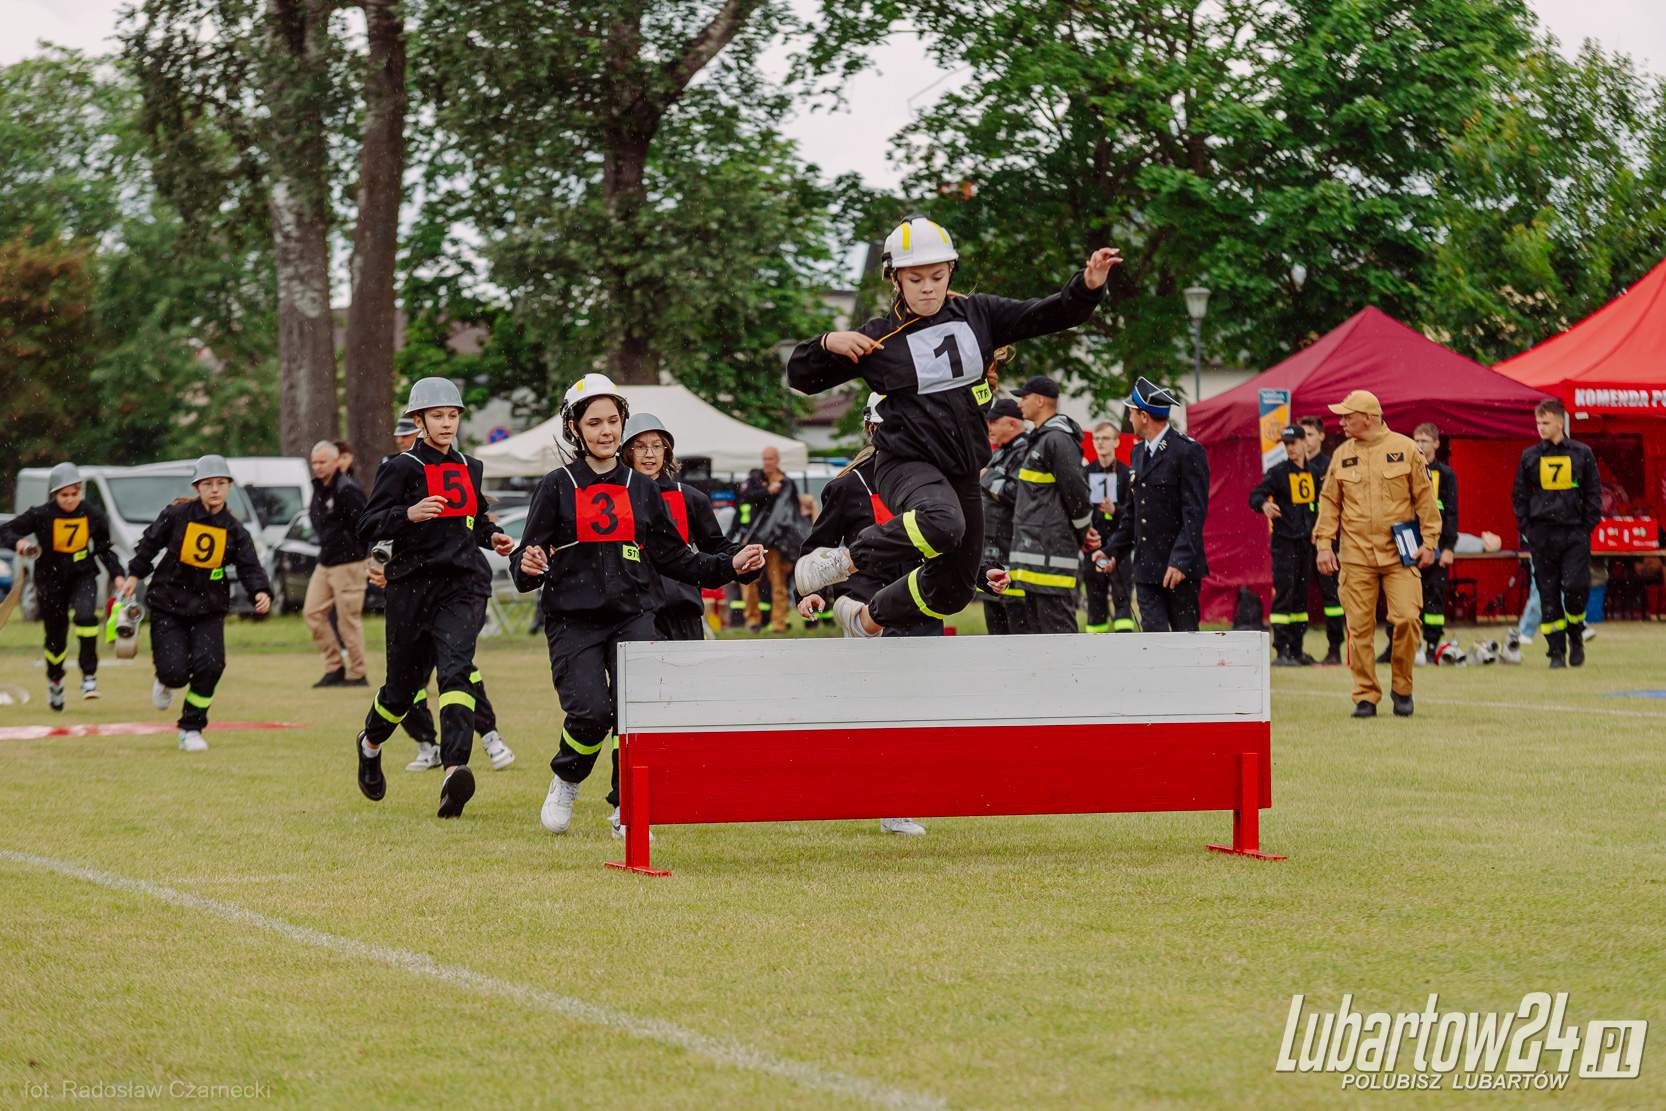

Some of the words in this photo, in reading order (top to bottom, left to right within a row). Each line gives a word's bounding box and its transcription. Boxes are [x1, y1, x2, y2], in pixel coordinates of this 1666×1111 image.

[933, 333, 964, 379] 1
[1548, 463, 1563, 482] 7
[443, 470, 467, 509] 5
[1098, 478, 1107, 498] 1
[1299, 478, 1310, 499] 6
[591, 492, 619, 535] 3
[64, 524, 80, 547] 7
[193, 533, 215, 562] 9
